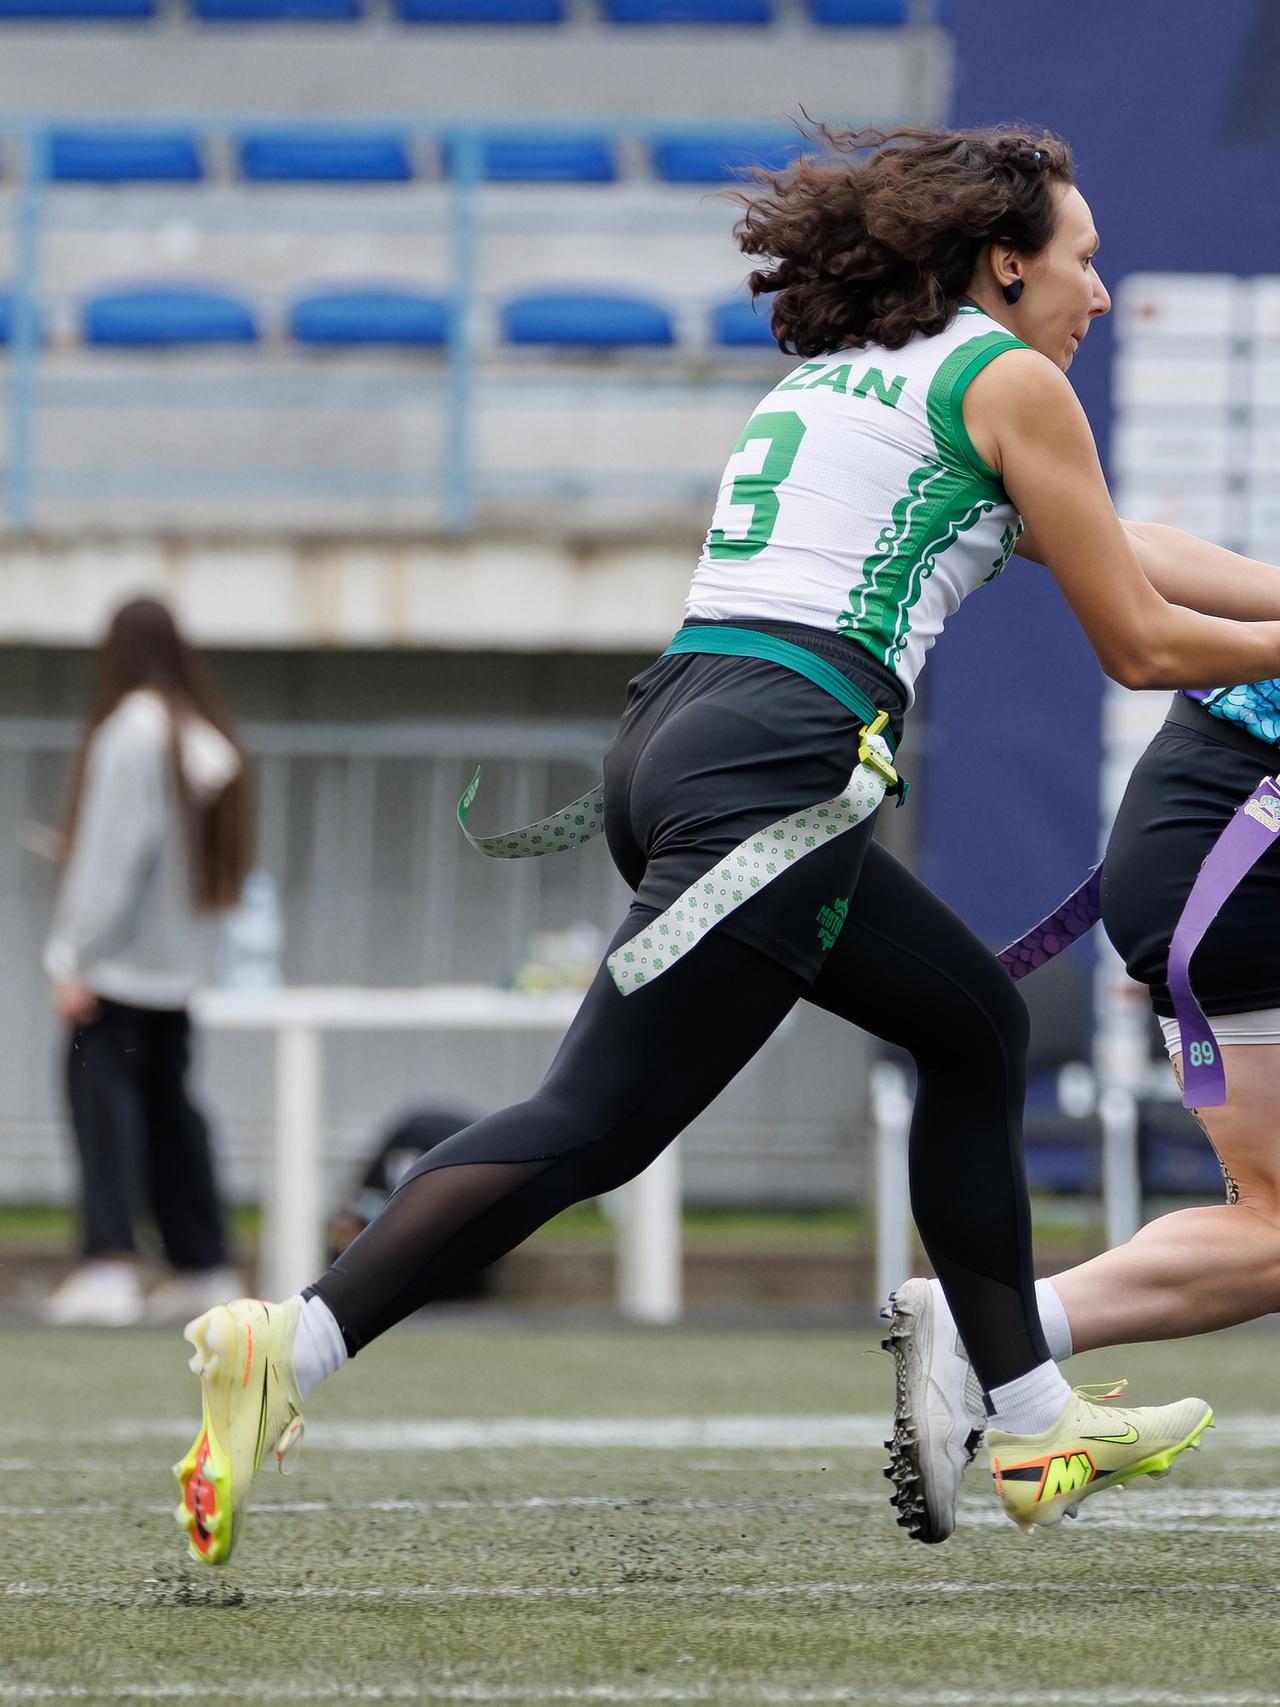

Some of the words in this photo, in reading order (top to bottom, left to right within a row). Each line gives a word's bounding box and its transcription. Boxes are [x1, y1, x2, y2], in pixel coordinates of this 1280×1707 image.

[774, 363, 907, 408] ZAN
[706, 411, 807, 560] 3
[1189, 1040, 1215, 1068] 89
